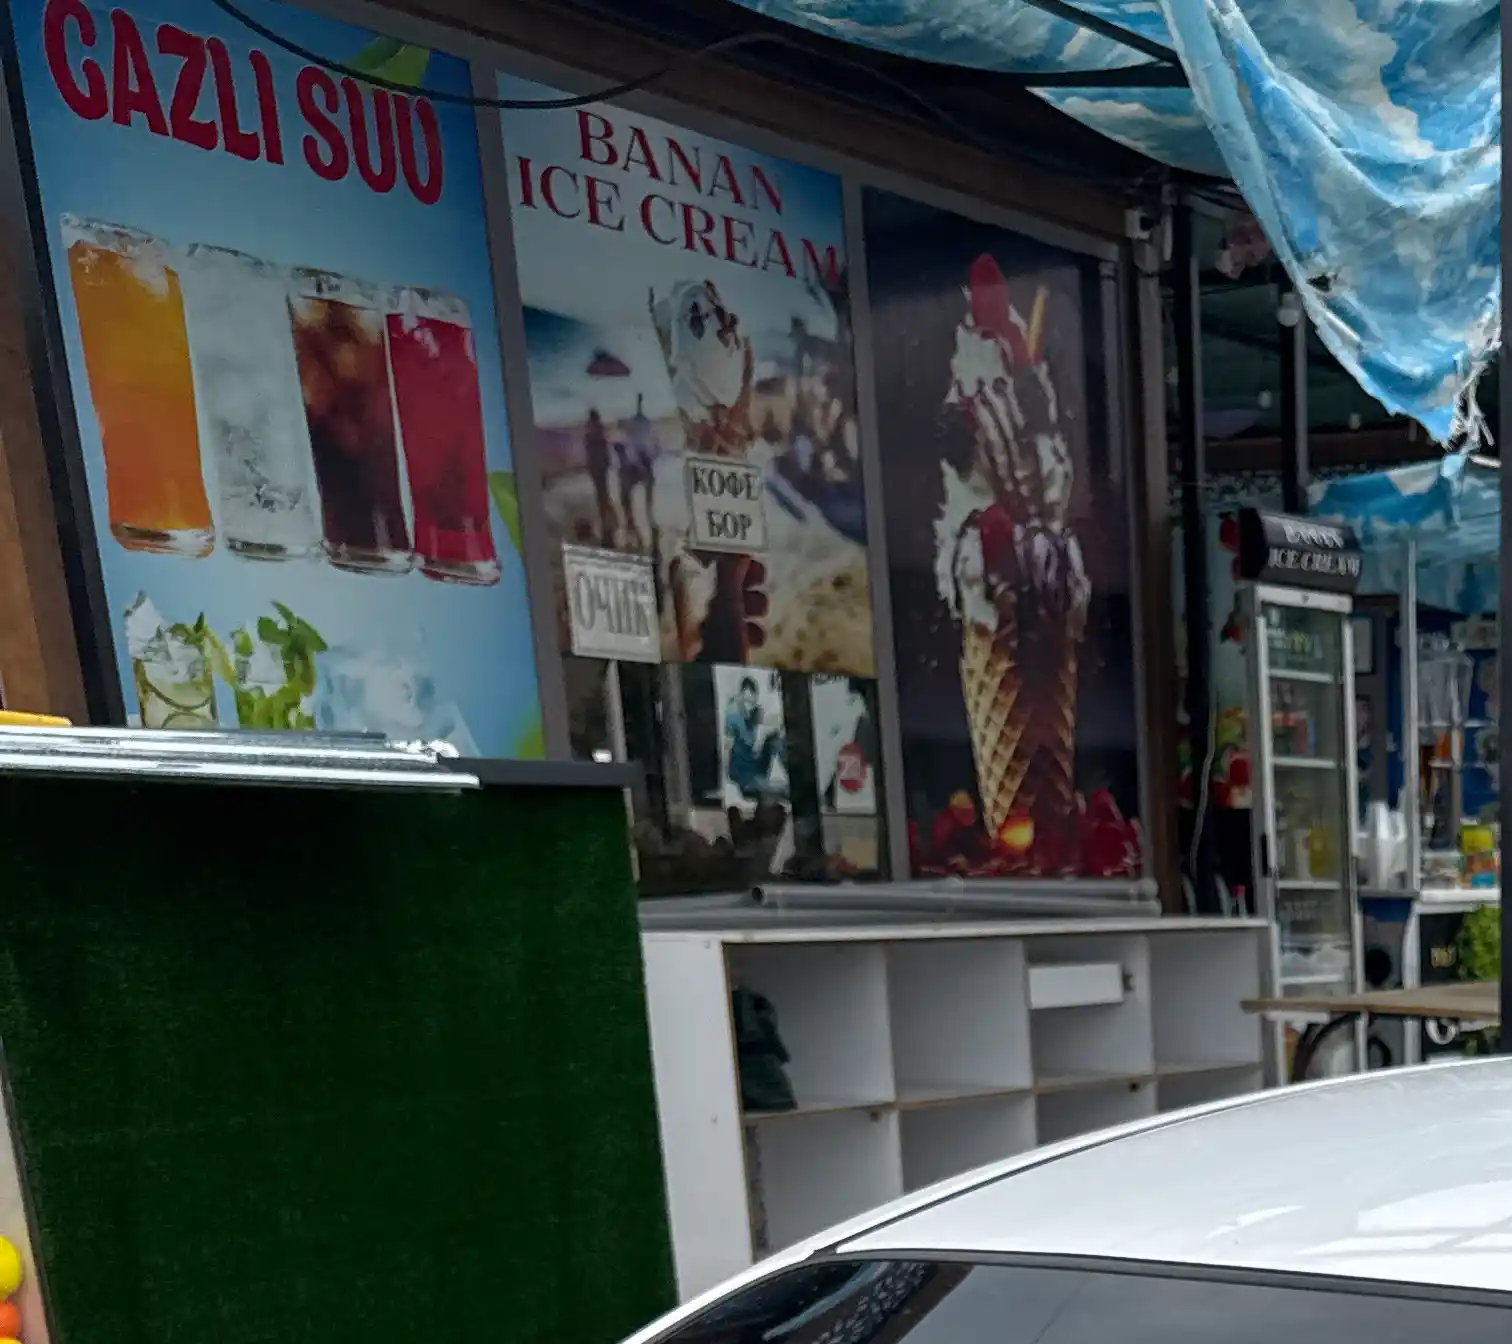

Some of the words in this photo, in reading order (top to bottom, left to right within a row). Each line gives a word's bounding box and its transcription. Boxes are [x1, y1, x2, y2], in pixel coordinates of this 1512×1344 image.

[296, 65, 443, 205] SUU
[576, 109, 782, 216] BANAN
[515, 155, 625, 232] ICE
[639, 193, 843, 292] CREAM
[692, 466, 763, 501] КОФЕ
